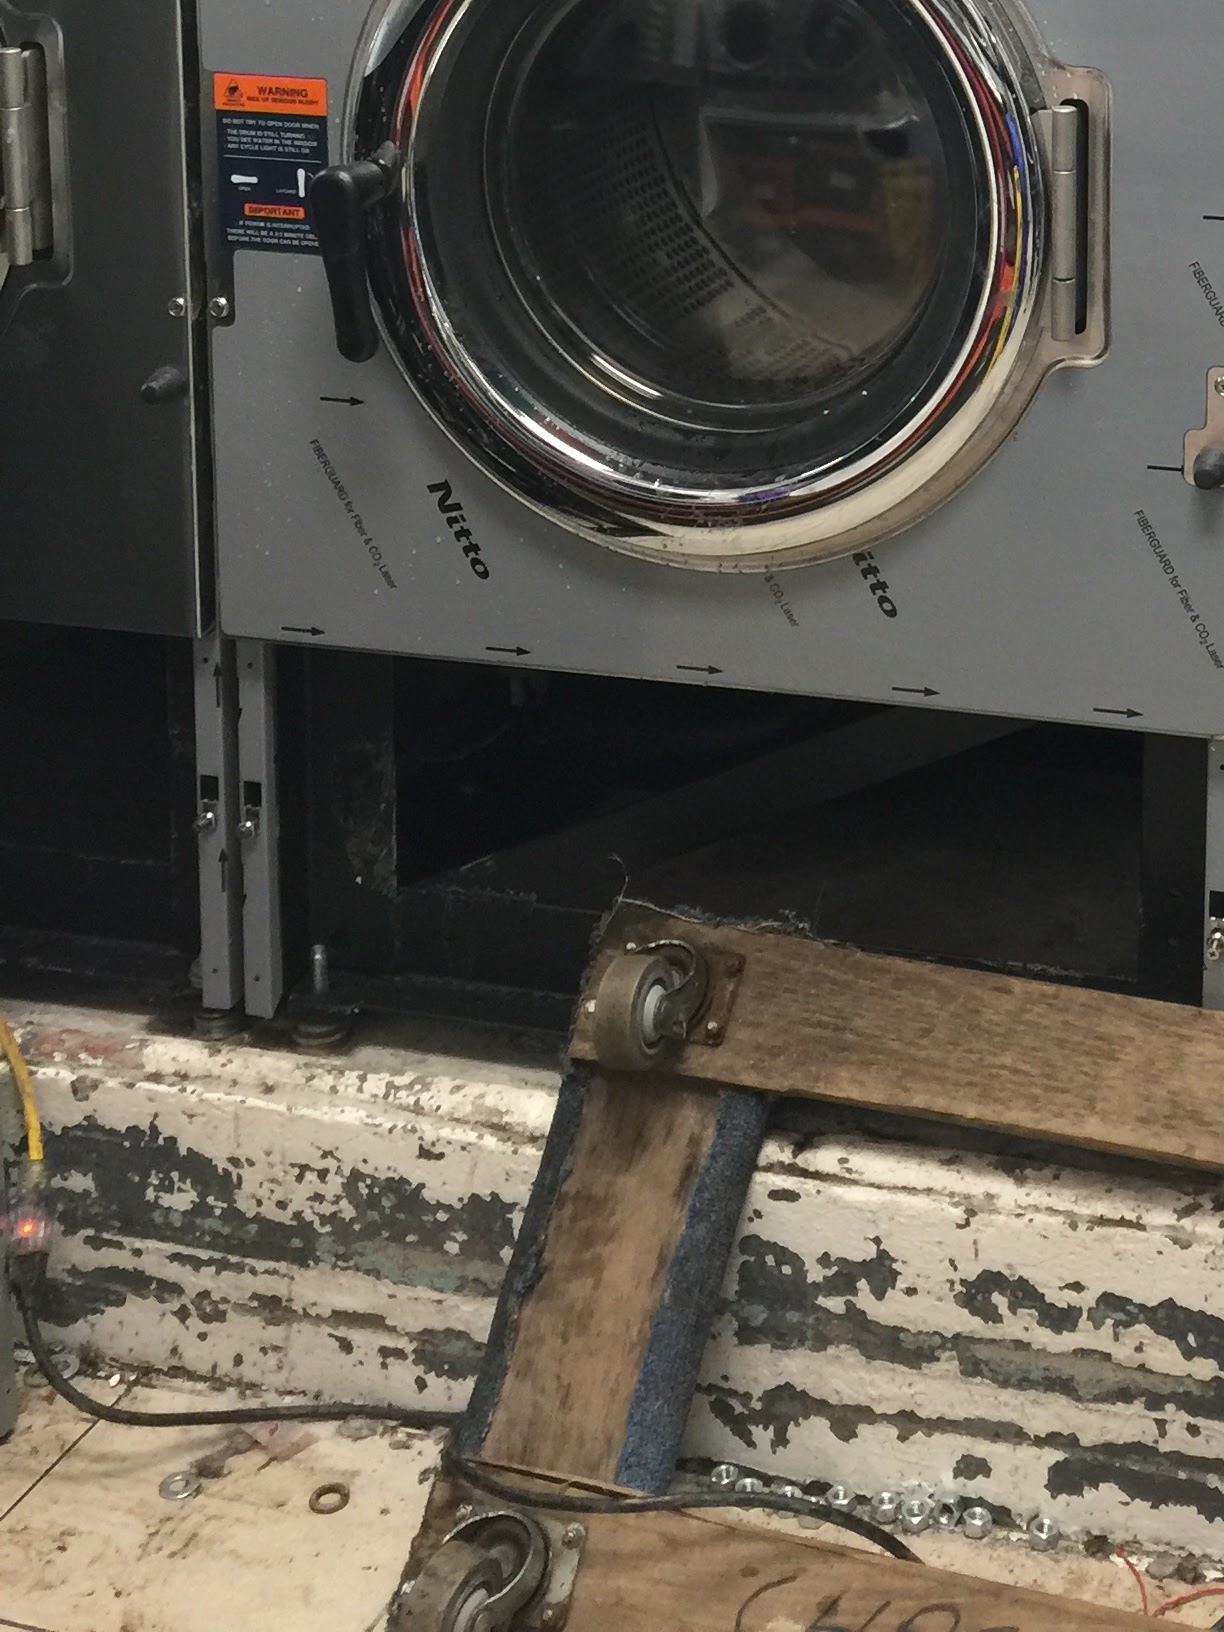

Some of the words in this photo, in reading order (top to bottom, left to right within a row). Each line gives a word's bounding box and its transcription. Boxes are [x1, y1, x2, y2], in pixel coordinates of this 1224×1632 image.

[256, 85, 309, 98] WARNING
[248, 206, 300, 217] IMPORTANT
[309, 438, 349, 501] FIBERGUARD
[350, 513, 368, 537] Fiber
[363, 537, 373, 546] &
[378, 563, 398, 590] Laser
[426, 479, 490, 580] Nitto
[780, 601, 799, 628] Laser
[852, 550, 898, 618] itto
[1133, 509, 1175, 576] FIBERGUARD
[1168, 575, 1182, 589] for
[1176, 588, 1195, 615] Fiber
[1189, 614, 1201, 624] &
[1205, 642, 1224, 670] Laser
